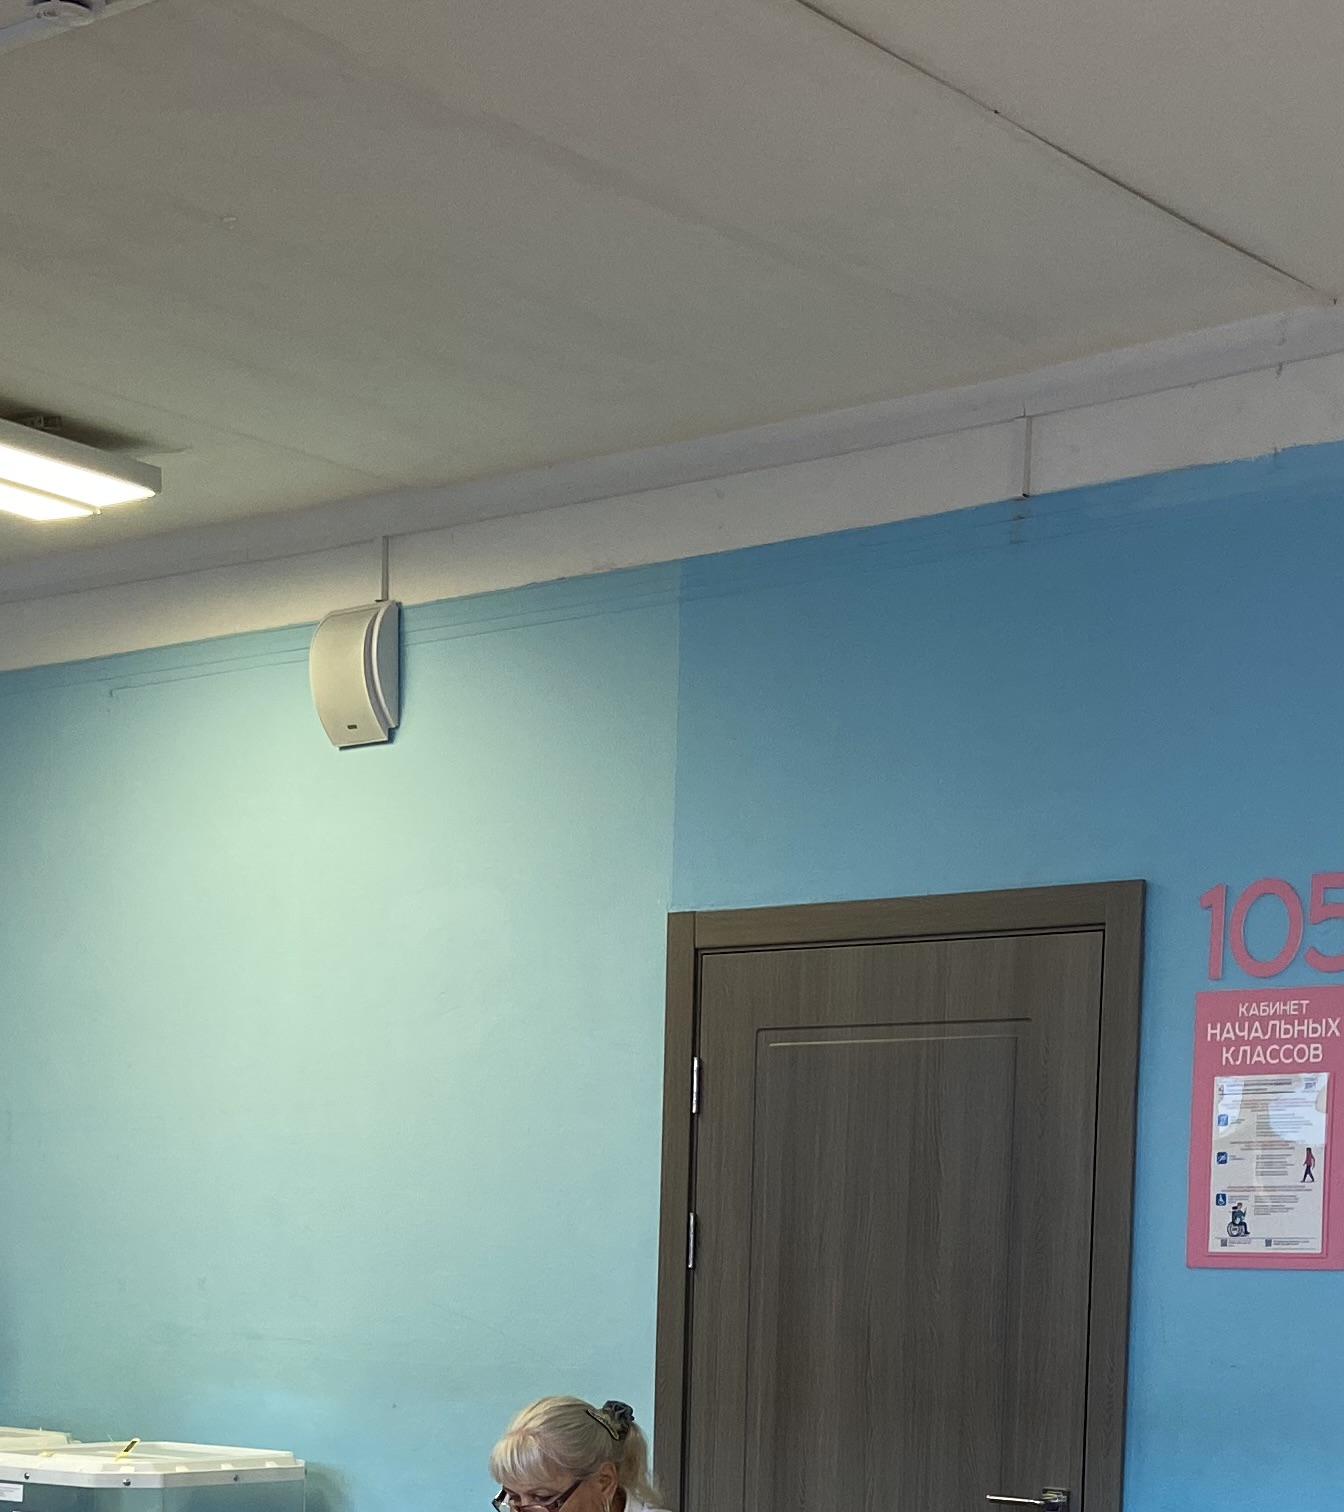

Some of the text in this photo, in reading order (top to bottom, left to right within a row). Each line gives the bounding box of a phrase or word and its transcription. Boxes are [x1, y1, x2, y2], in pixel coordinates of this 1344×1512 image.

[1238, 1000, 1310, 1017] КАБИНЕТ
[1206, 1018, 1341, 1042] НАЧАЛЬНЫХ
[1221, 1043, 1323, 1066] КЛАССОВ
